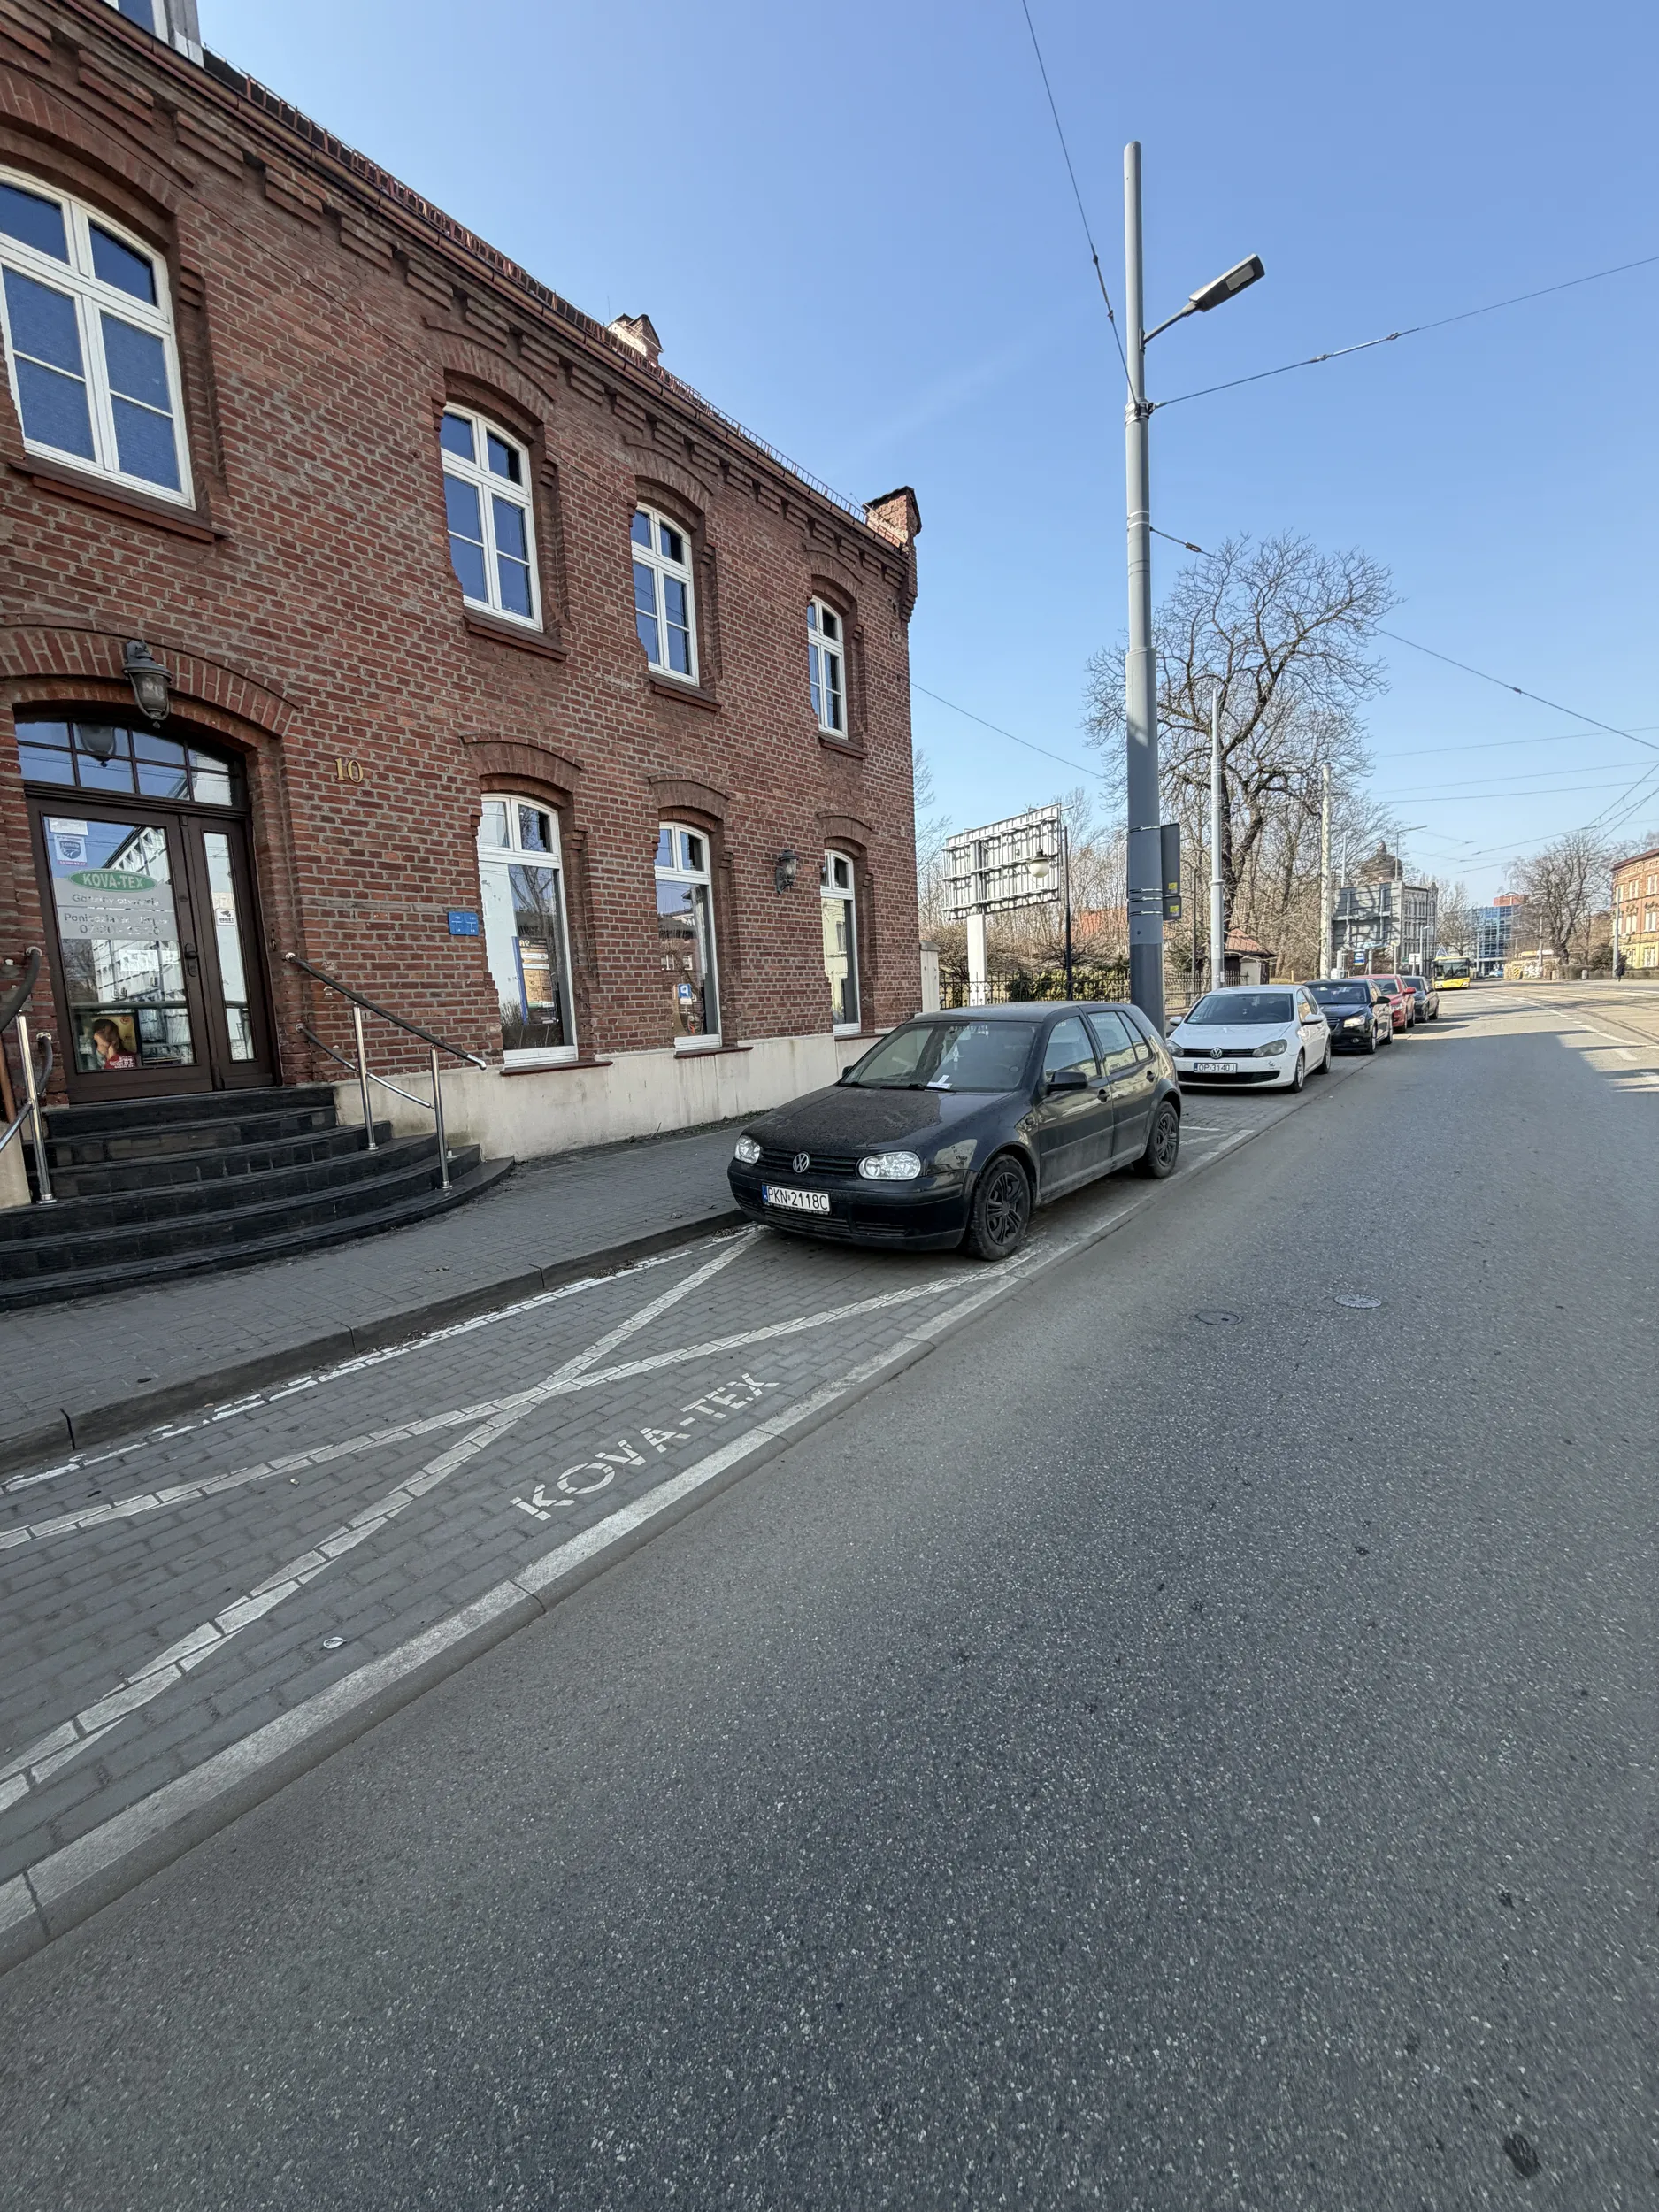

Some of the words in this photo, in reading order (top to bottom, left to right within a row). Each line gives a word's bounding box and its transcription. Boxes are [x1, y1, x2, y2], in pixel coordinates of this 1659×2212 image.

[334, 757, 364, 783] 10
[82, 873, 144, 889] KOVA-TEX
[509, 1372, 780, 1521] KOVA-TEX
